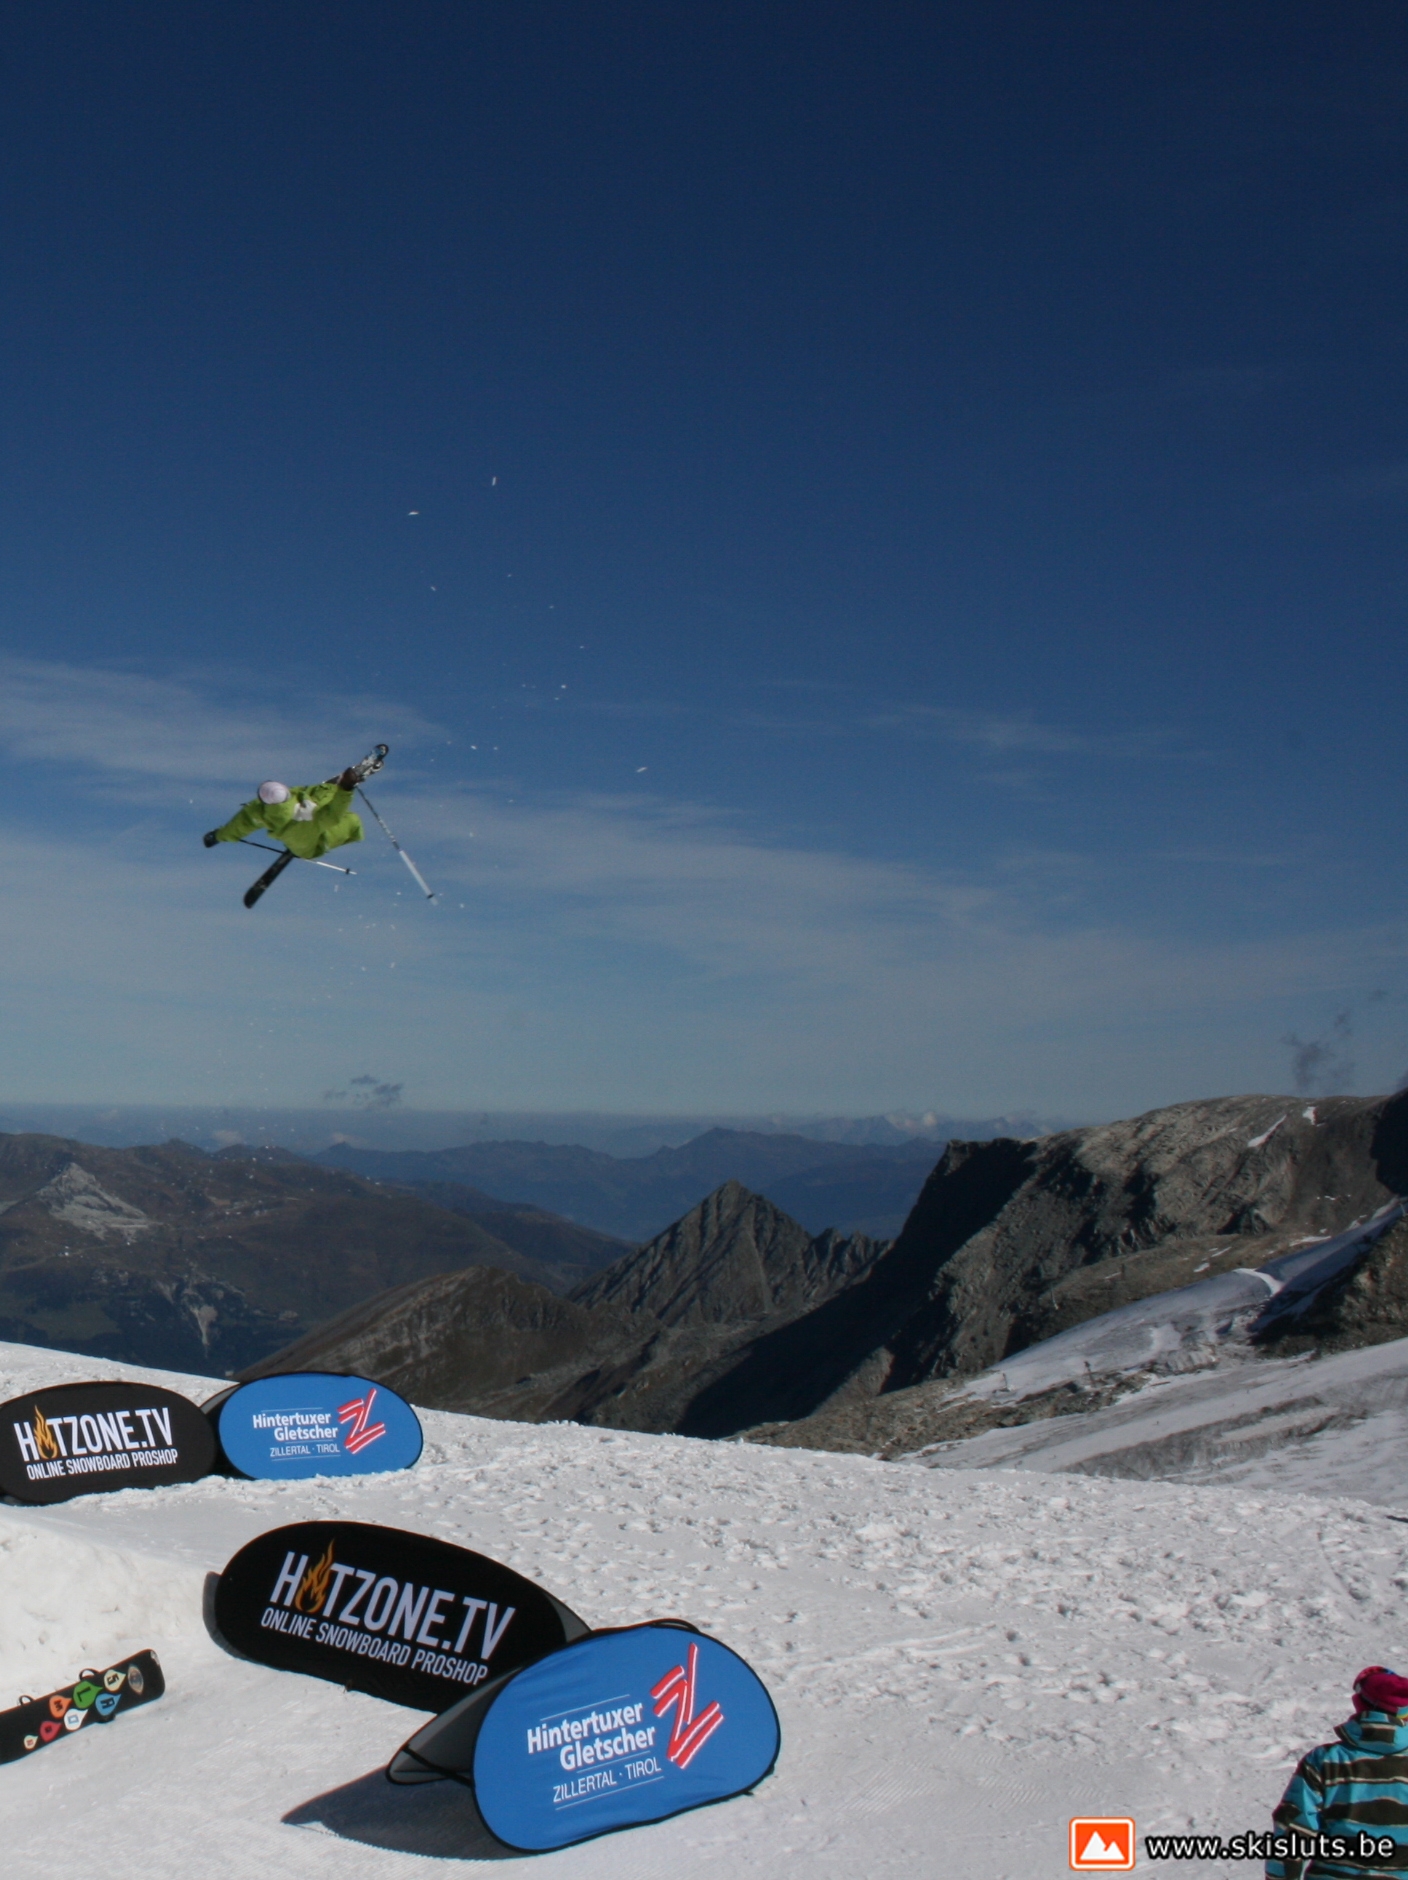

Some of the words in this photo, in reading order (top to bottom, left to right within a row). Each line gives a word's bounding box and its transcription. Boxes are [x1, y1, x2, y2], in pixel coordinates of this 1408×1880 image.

[252, 1412, 331, 1429] Hintertuxer
[274, 1425, 338, 1441] Gletscher
[26, 1460, 66, 1480] ONLINE
[66, 1453, 130, 1475] SNOWBOARD
[132, 1448, 178, 1467] PROSHOP
[270, 1445, 311, 1457] ZILLERTAL
[316, 1443, 340, 1454] TIROL
[260, 1606, 315, 1641] ONLINE
[315, 1622, 411, 1668] SNOWBOARD
[410, 1649, 488, 1686] PROSHOP
[527, 1702, 643, 1754] Hintertuxer
[559, 1725, 656, 1771] Gletscher
[553, 1769, 617, 1803] ZILLERTAL
[624, 1756, 662, 1781] TIROL
